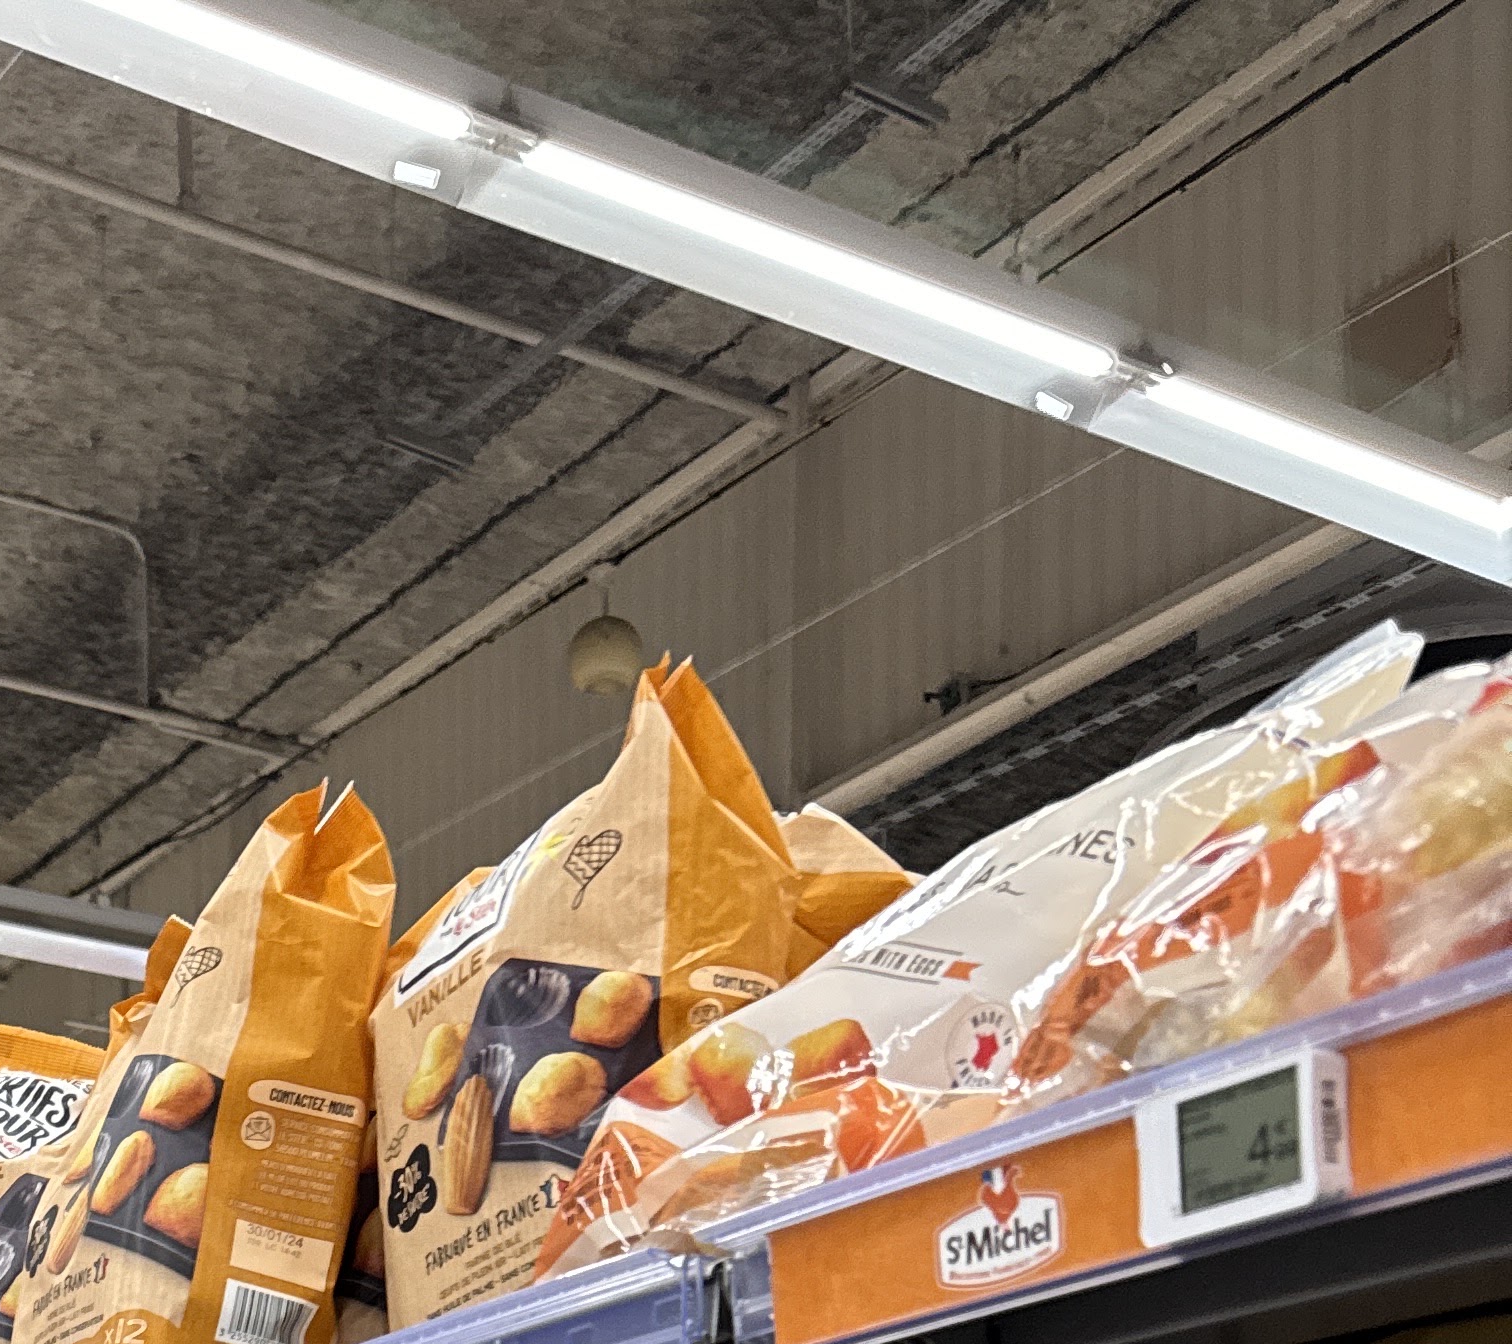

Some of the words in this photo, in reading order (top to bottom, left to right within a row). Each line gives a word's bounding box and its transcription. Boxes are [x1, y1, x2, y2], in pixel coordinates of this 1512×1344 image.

[909, 954, 944, 978] EGGS
[407, 947, 484, 1028] VANILLE
[269, 1087, 356, 1118] CONTACTEZ-NOUS
[496, 1193, 541, 1235] FRANCE
[246, 1222, 305, 1249] 30/01/24
[966, 1208, 1052, 1266] Michel
